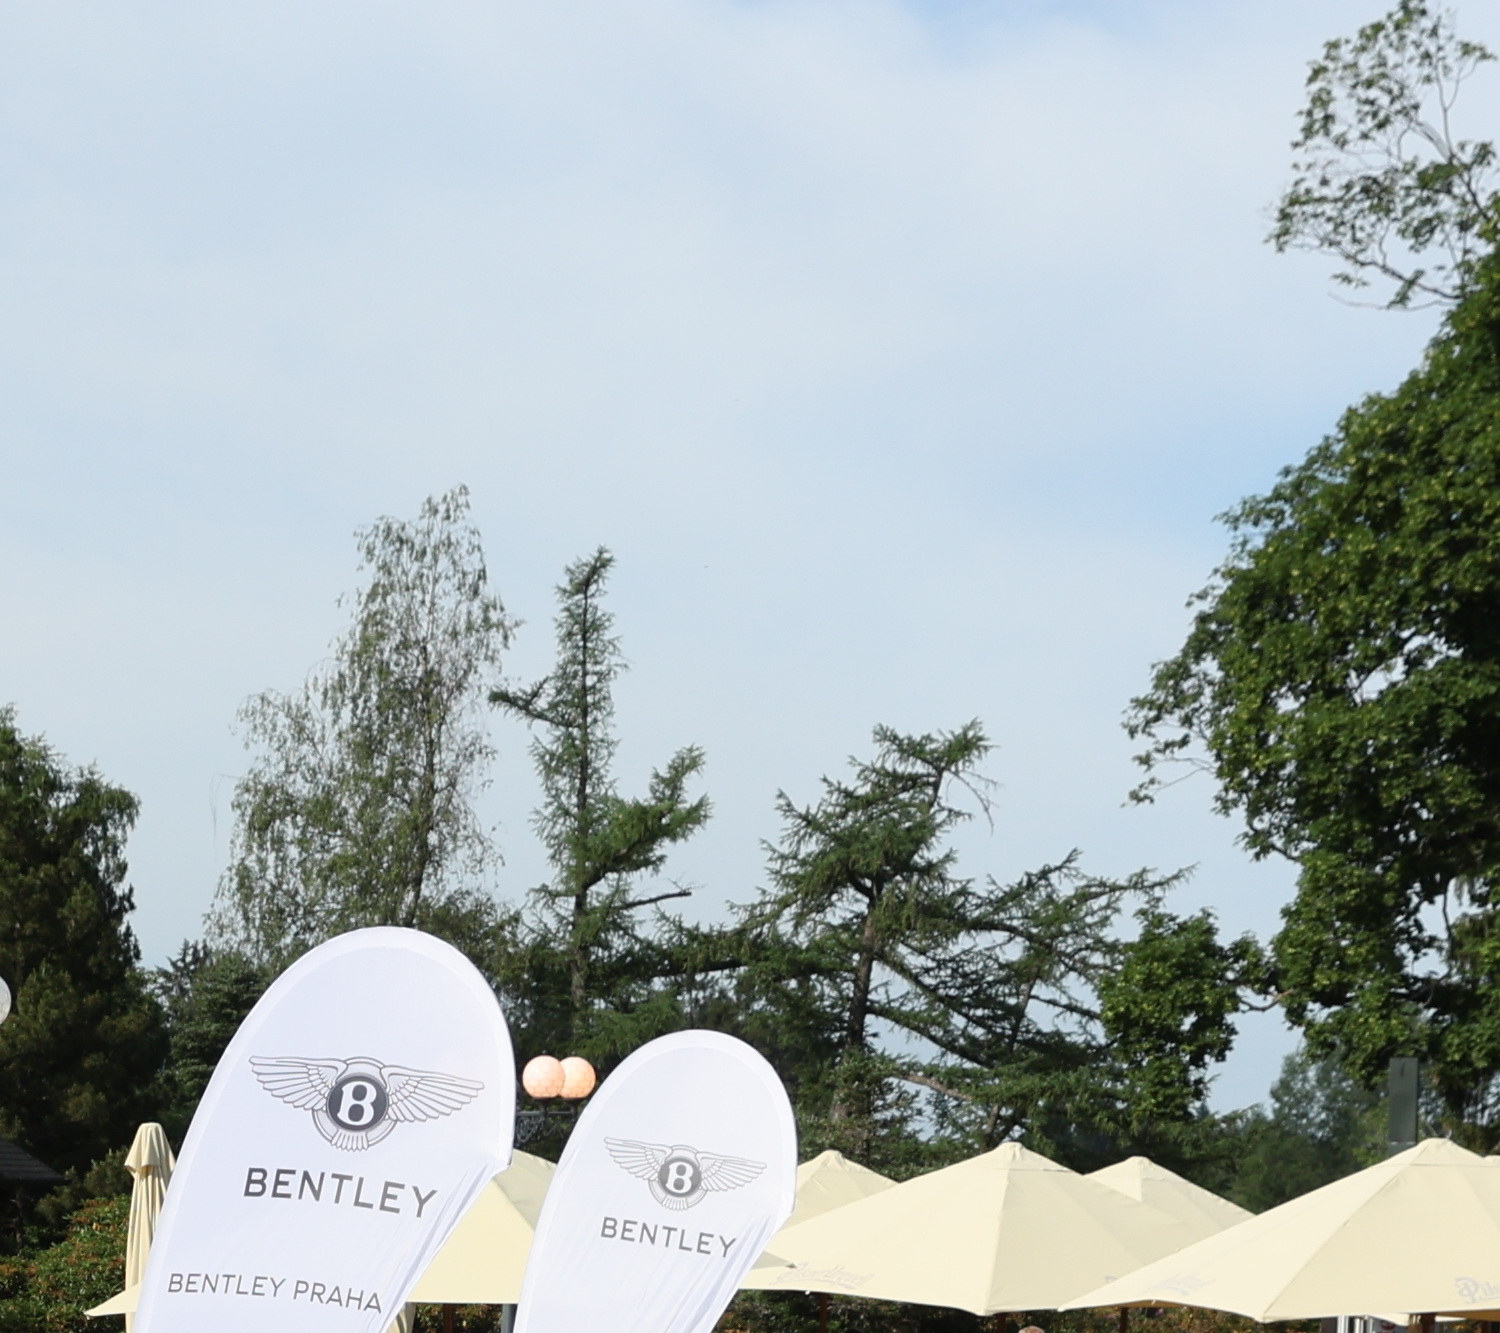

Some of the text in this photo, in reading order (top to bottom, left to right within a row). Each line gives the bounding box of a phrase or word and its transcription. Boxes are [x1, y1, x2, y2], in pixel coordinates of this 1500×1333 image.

[243, 1166, 438, 1218] BENTLEY
[600, 1216, 737, 1258] BENTLEY
[168, 1272, 382, 1314] BENTLEY PRAHA
